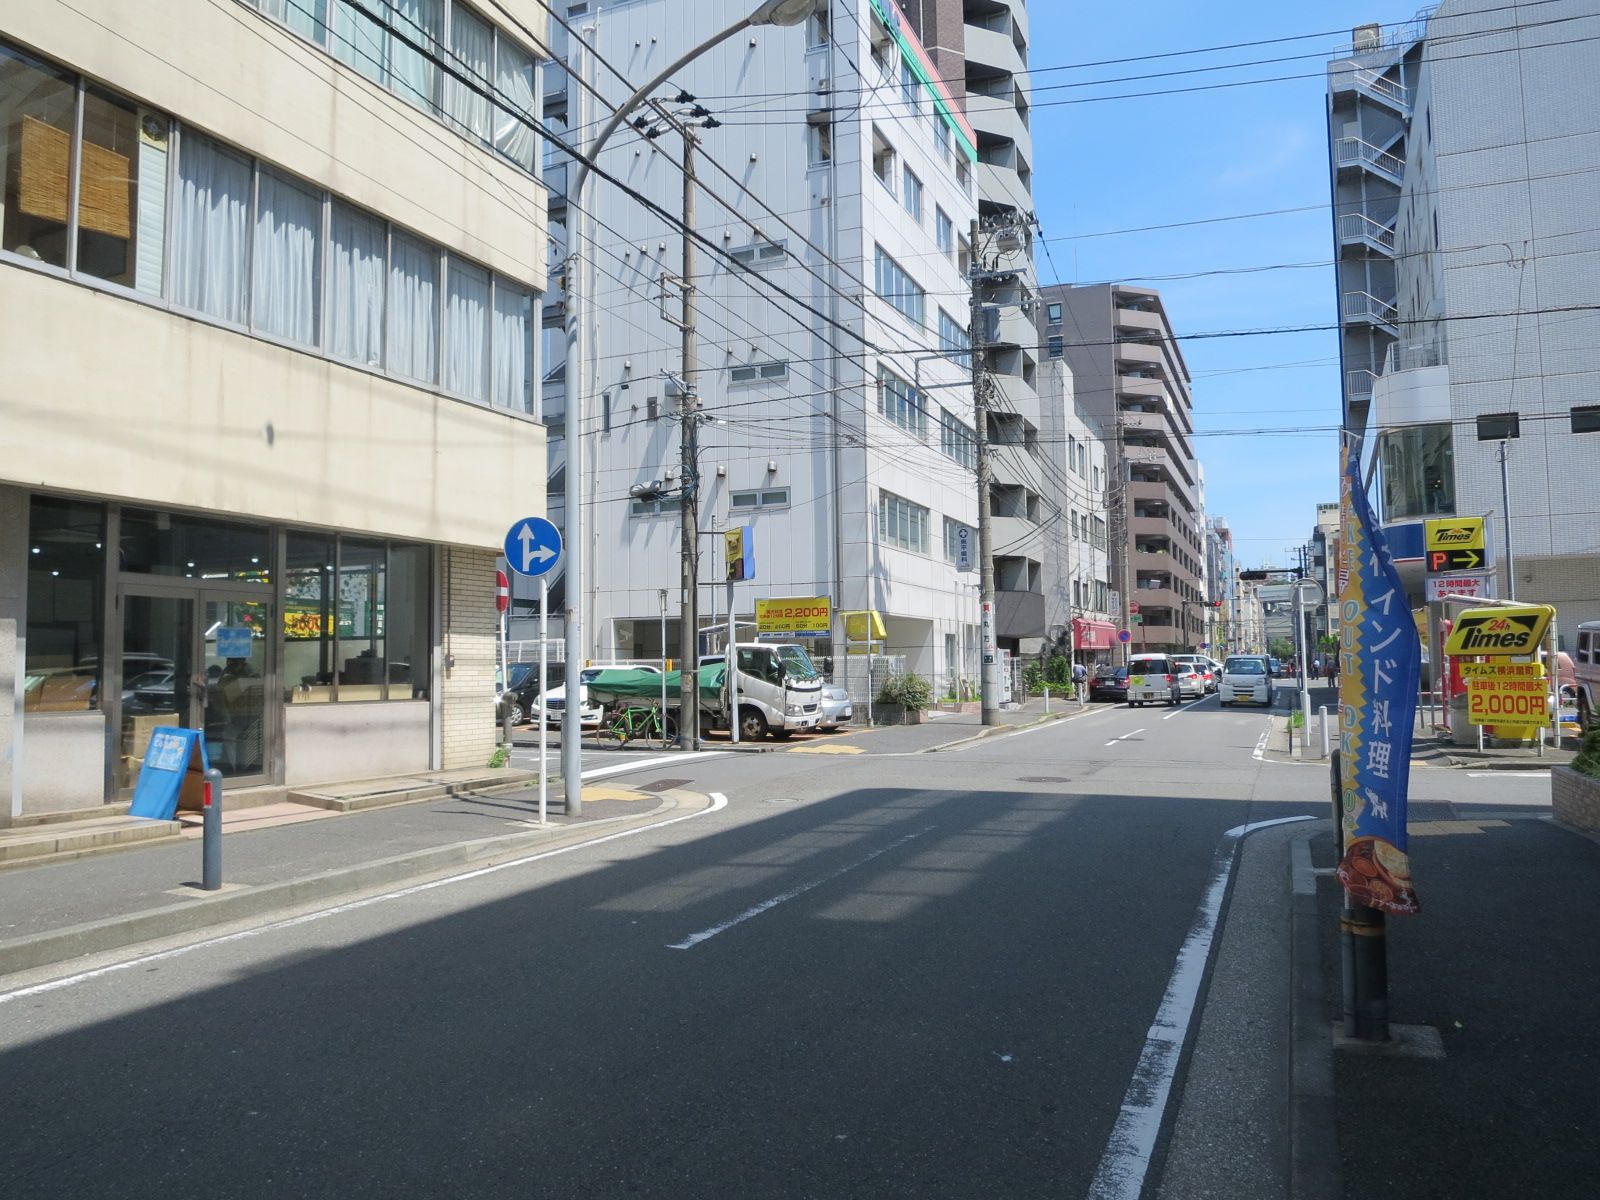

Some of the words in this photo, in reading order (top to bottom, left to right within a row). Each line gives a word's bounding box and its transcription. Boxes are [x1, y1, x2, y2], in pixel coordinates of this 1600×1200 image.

[1436, 531, 1471, 542] Times
[1433, 552, 1447, 571] P
[1433, 579, 1480, 588] 12時間最大
[784, 607, 828, 618] 2,200円
[1488, 619, 1510, 631] 24h
[1343, 600, 1359, 675] OUT
[1461, 626, 1531, 650] Times
[1471, 694, 1545, 716] 2,000円
